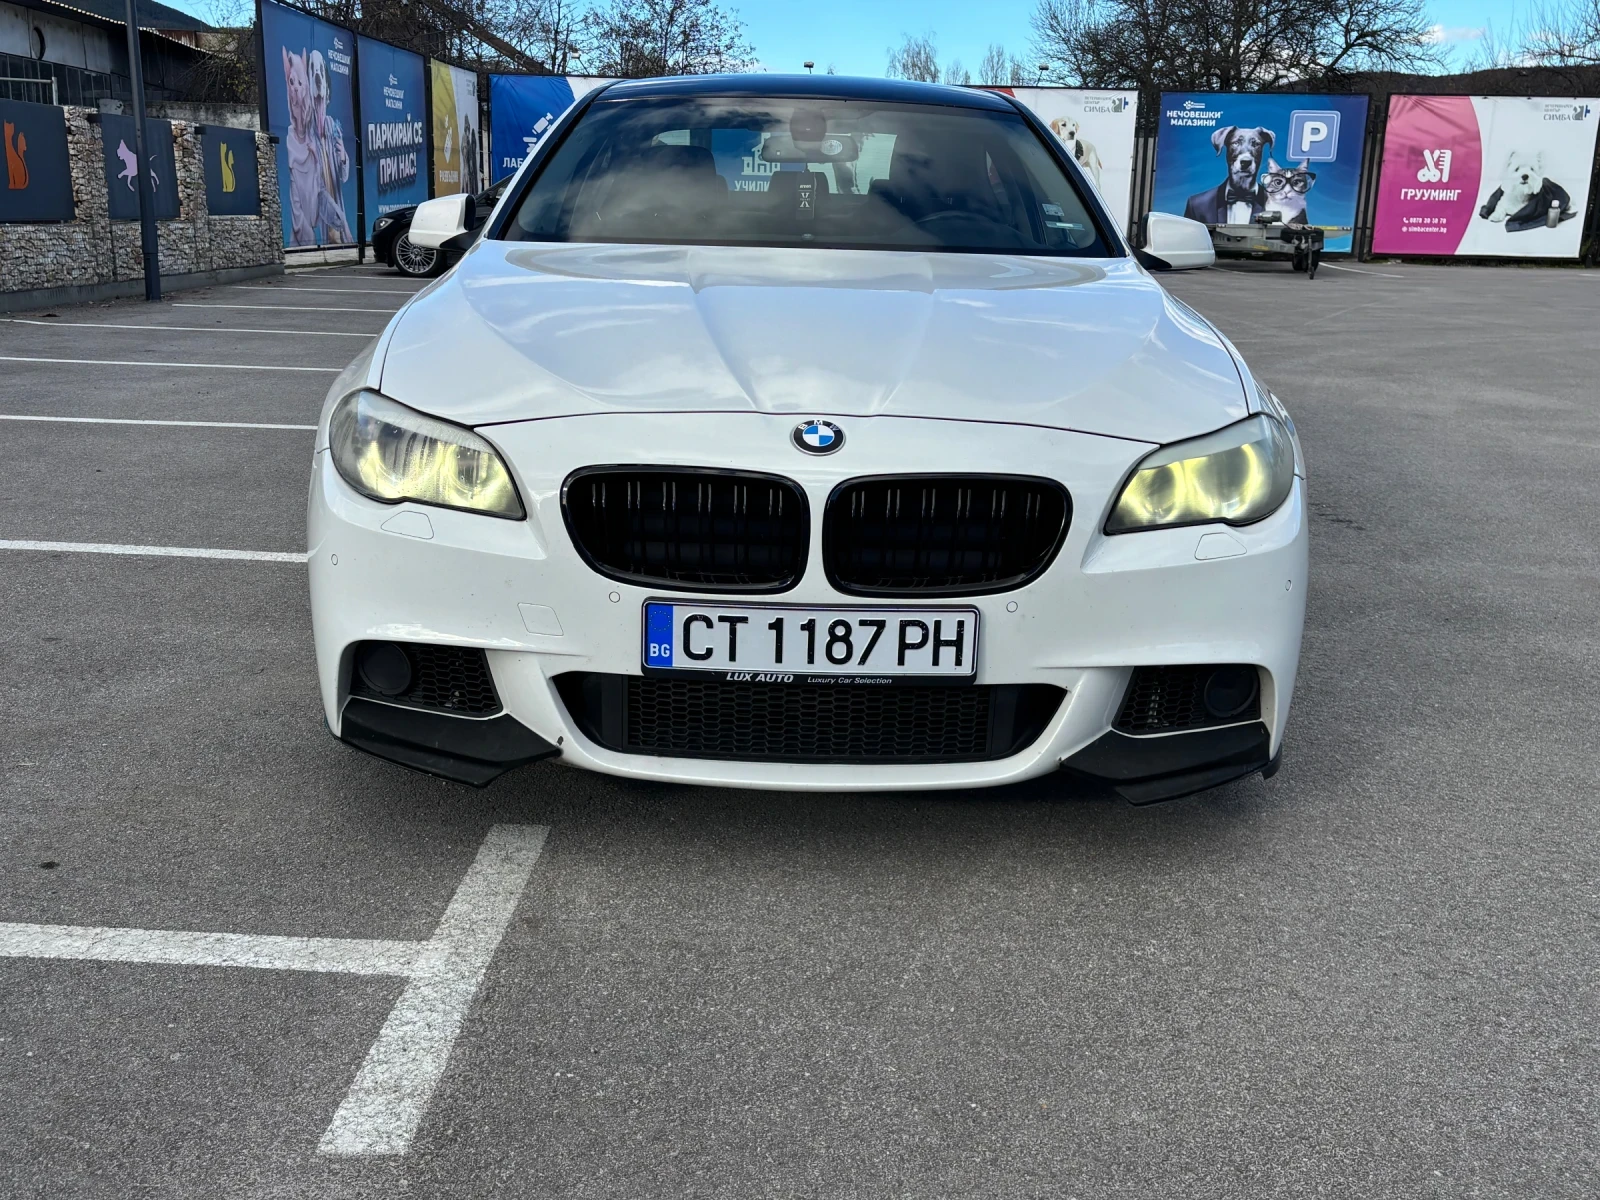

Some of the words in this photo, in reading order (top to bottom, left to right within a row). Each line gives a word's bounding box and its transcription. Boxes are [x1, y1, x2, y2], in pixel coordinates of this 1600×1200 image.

[1083, 105, 1111, 113] СИМБА
[1170, 118, 1216, 126] МАГАЗИНИ
[1543, 113, 1571, 121] СИМБА
[368, 113, 413, 150] ПАРКИРАЙ
[413, 121, 423, 144] СЕ
[1301, 121, 1328, 152] P
[380, 153, 398, 185] ПРИ
[399, 151, 417, 179] НАС!
[503, 157, 525, 168] ЛАБ
[734, 180, 770, 191] УЧИЛИ
[1400, 188, 1462, 201] ГРУУМИНГ
[797, 420, 840, 430] BMW
[683, 614, 749, 662] CT
[768, 617, 887, 665] 1187
[897, 619, 965, 667] PH
[650, 643, 670, 657] BG
[725, 673, 752, 682] LUX
[755, 674, 794, 683] AUTO
[807, 677, 835, 685] Luxury
[853, 677, 892, 685] Selection
